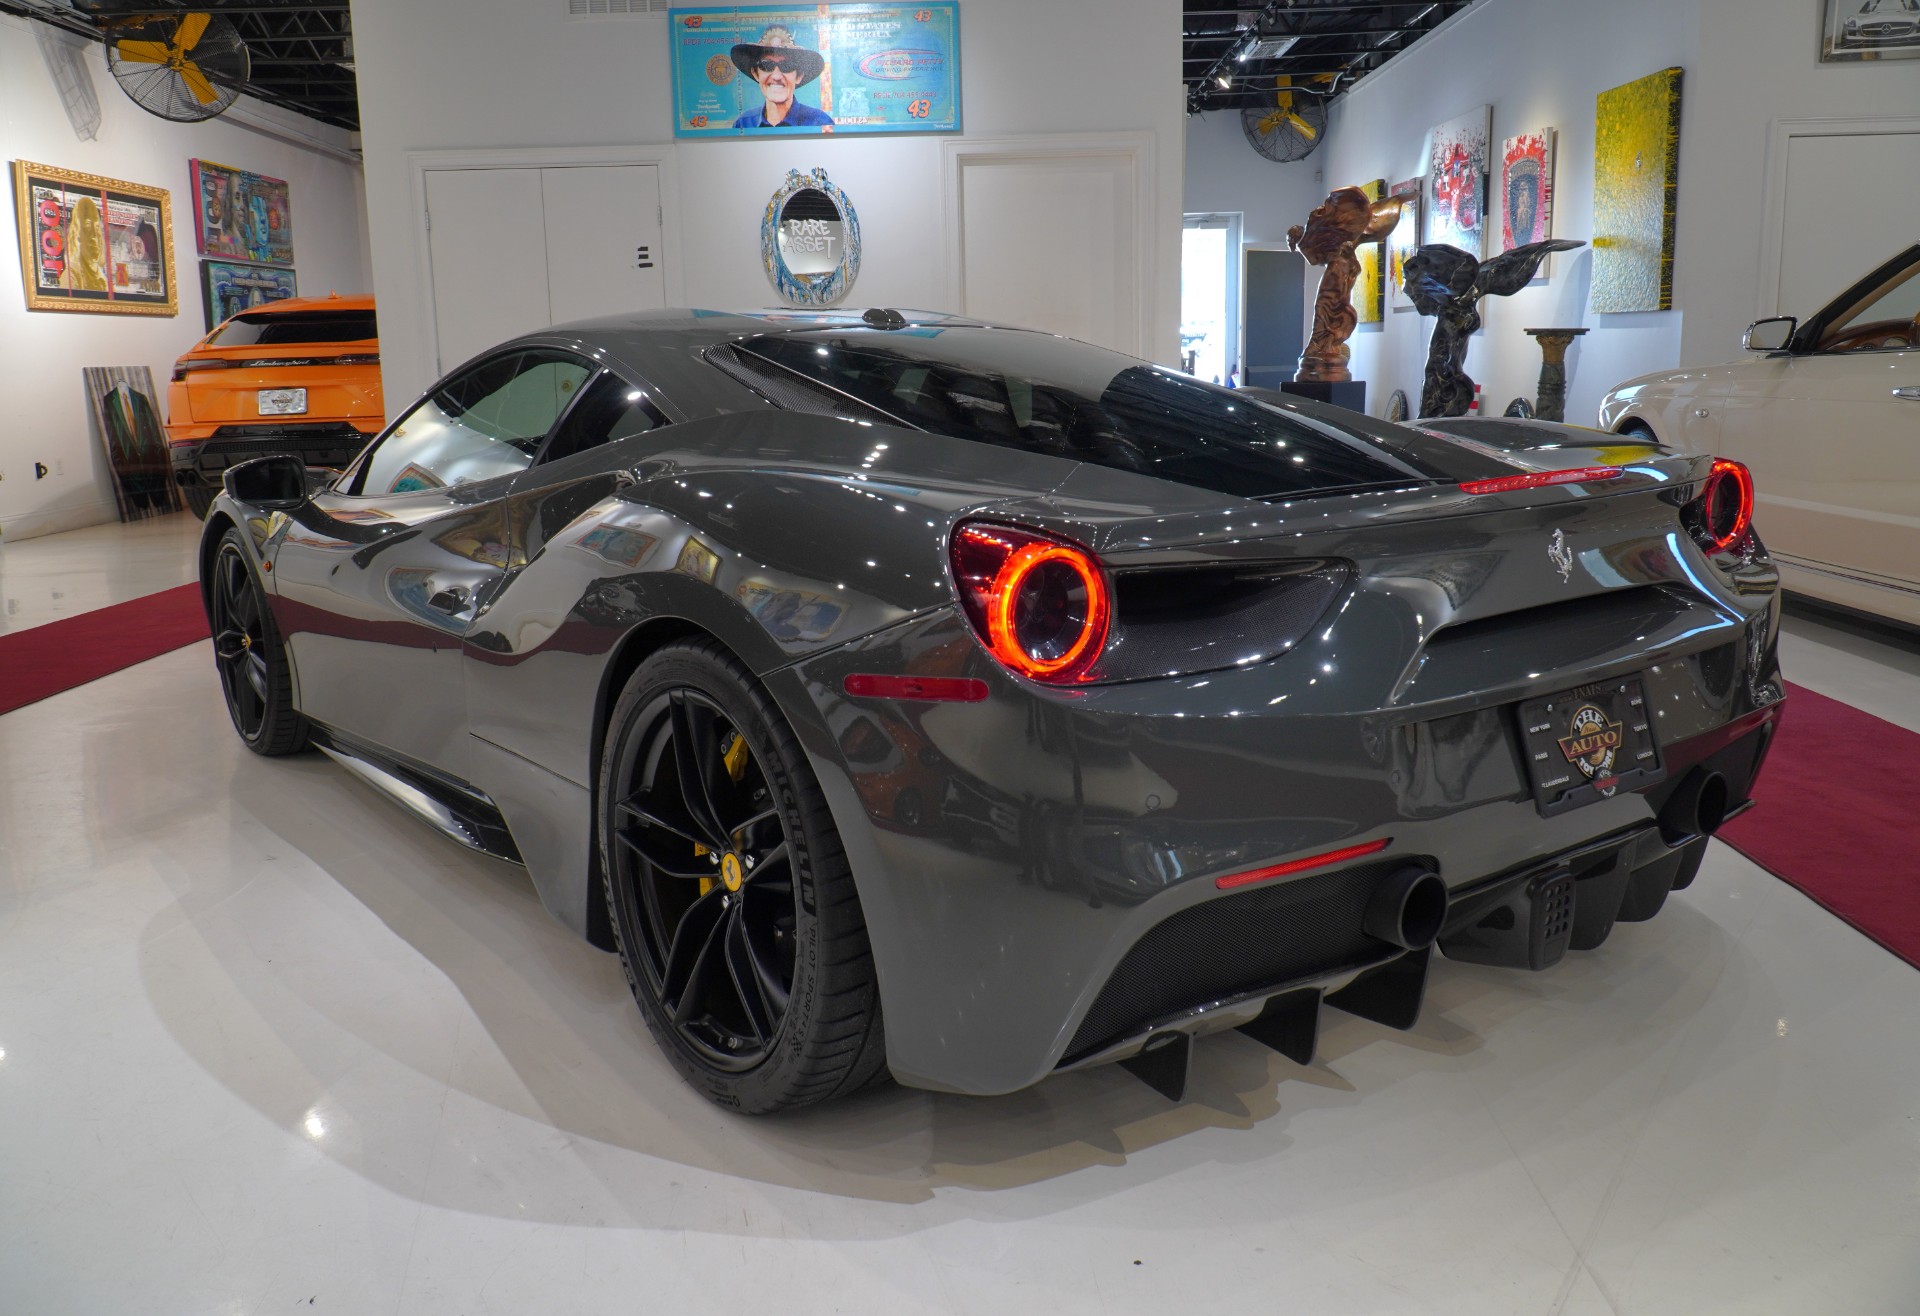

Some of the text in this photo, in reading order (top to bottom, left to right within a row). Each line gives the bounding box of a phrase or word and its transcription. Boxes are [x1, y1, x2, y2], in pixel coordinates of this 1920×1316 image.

[684, 16, 702, 28] 43
[914, 9, 932, 22] 43
[907, 99, 932, 119] 43
[690, 115, 709, 128] 43
[788, 218, 831, 237] RARE
[783, 236, 836, 259] ASSET
[1530, 722, 1551, 734] NEW YORK
[1574, 709, 1604, 732] THE
[1633, 724, 1648, 732] TOKYO
[1570, 730, 1617, 755] AUTO
[1535, 752, 1548, 761] PARIS
[1637, 751, 1653, 760] LONDON
[1579, 757, 1595, 775] TOY
[767, 750, 815, 907] MICHELIN
[808, 928, 816, 969] PILOT
[804, 974, 815, 1019] SPORT
